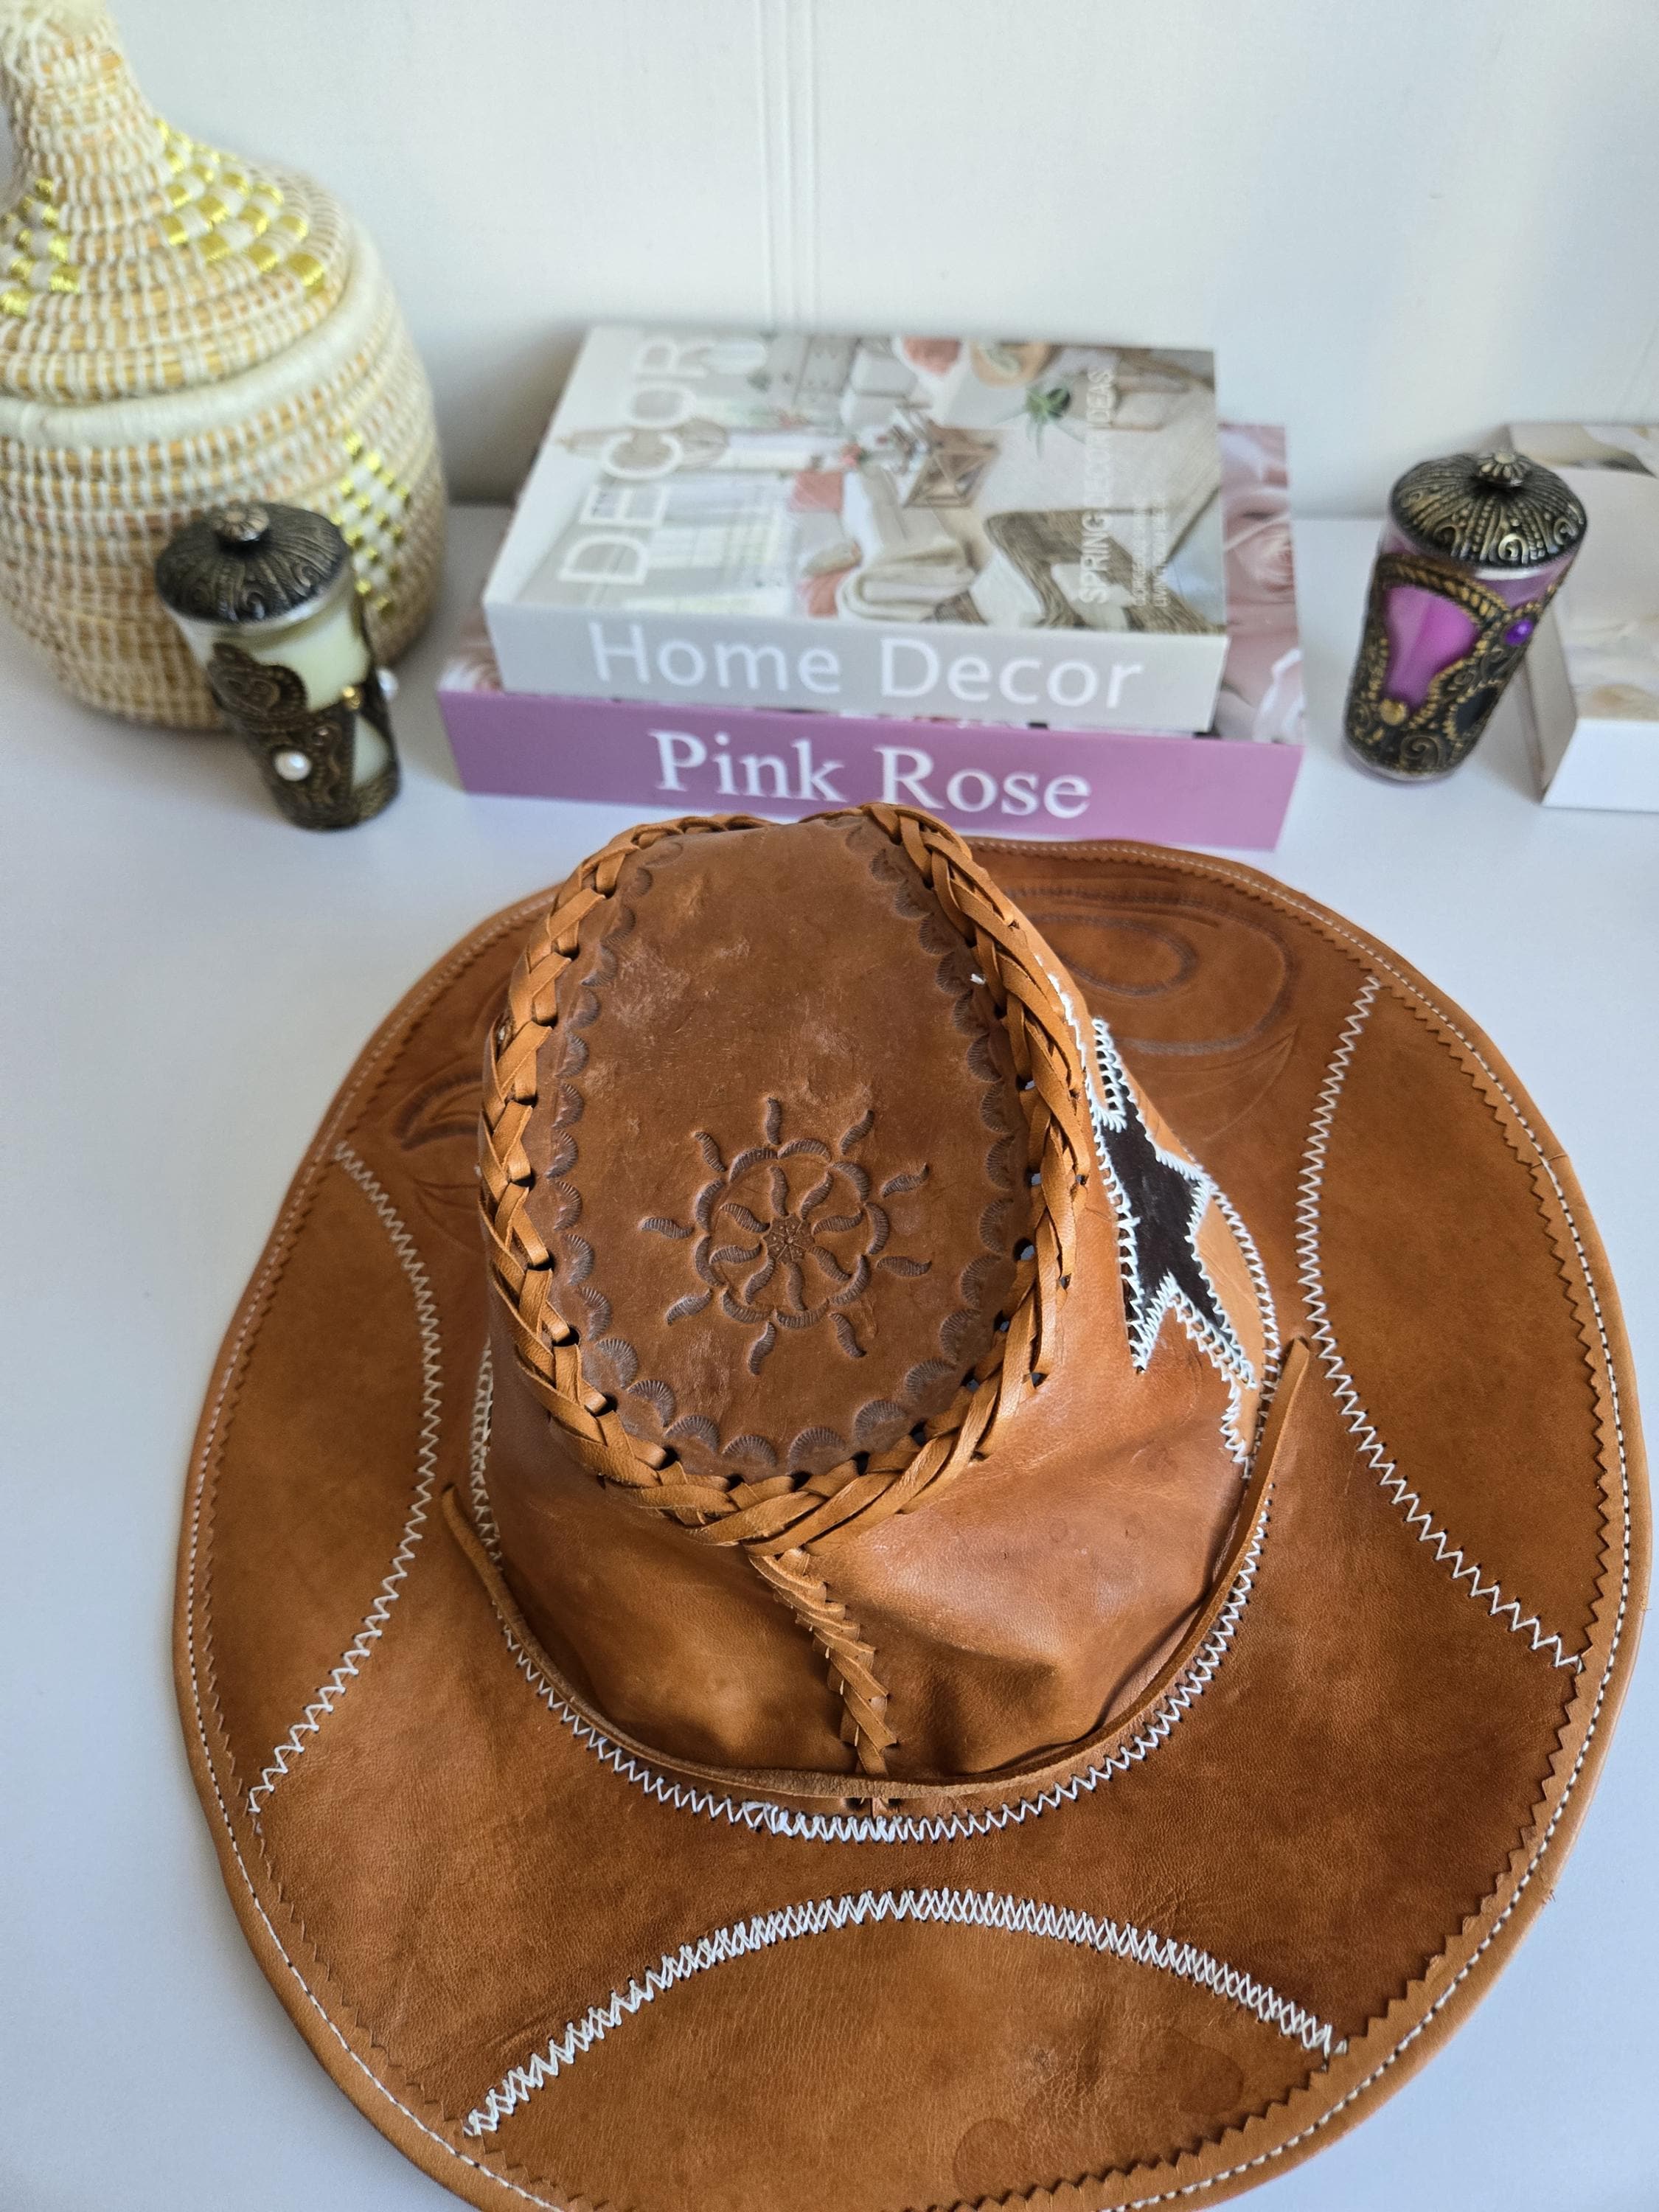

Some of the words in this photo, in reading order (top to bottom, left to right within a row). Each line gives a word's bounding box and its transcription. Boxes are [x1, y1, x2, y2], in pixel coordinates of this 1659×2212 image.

[1086, 366, 1116, 428] IDEAS
[557, 335, 709, 585] DECOR
[1079, 512, 1111, 605] SPRING
[588, 622, 841, 694] Home
[880, 637, 1145, 709] Decor
[647, 728, 848, 803] Pink
[874, 744, 1092, 819] Rose
